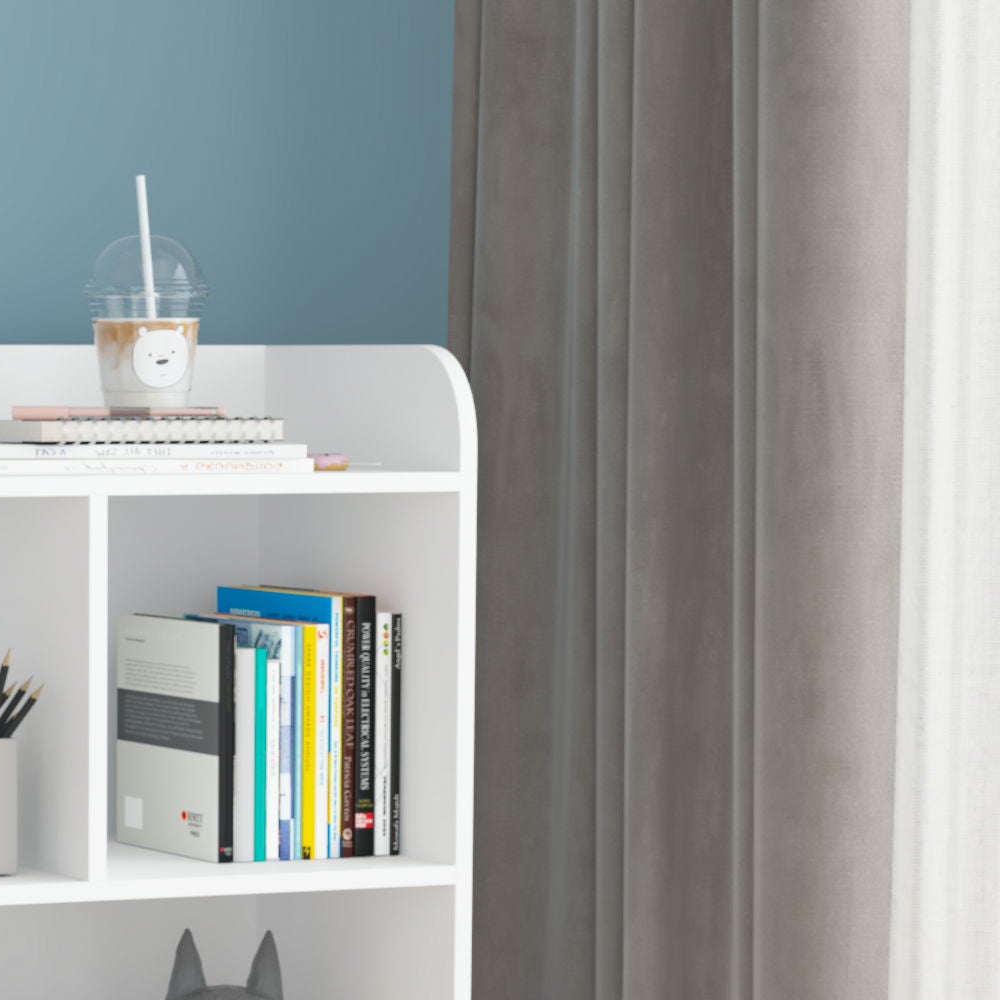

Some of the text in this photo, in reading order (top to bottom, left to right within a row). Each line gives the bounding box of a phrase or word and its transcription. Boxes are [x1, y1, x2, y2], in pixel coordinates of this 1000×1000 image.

[361, 622, 371, 650] POWER
[360, 652, 371, 689] QUALITY
[361, 699, 370, 750] ELECTRICAL
[360, 752, 370, 790] SYSTEMS
